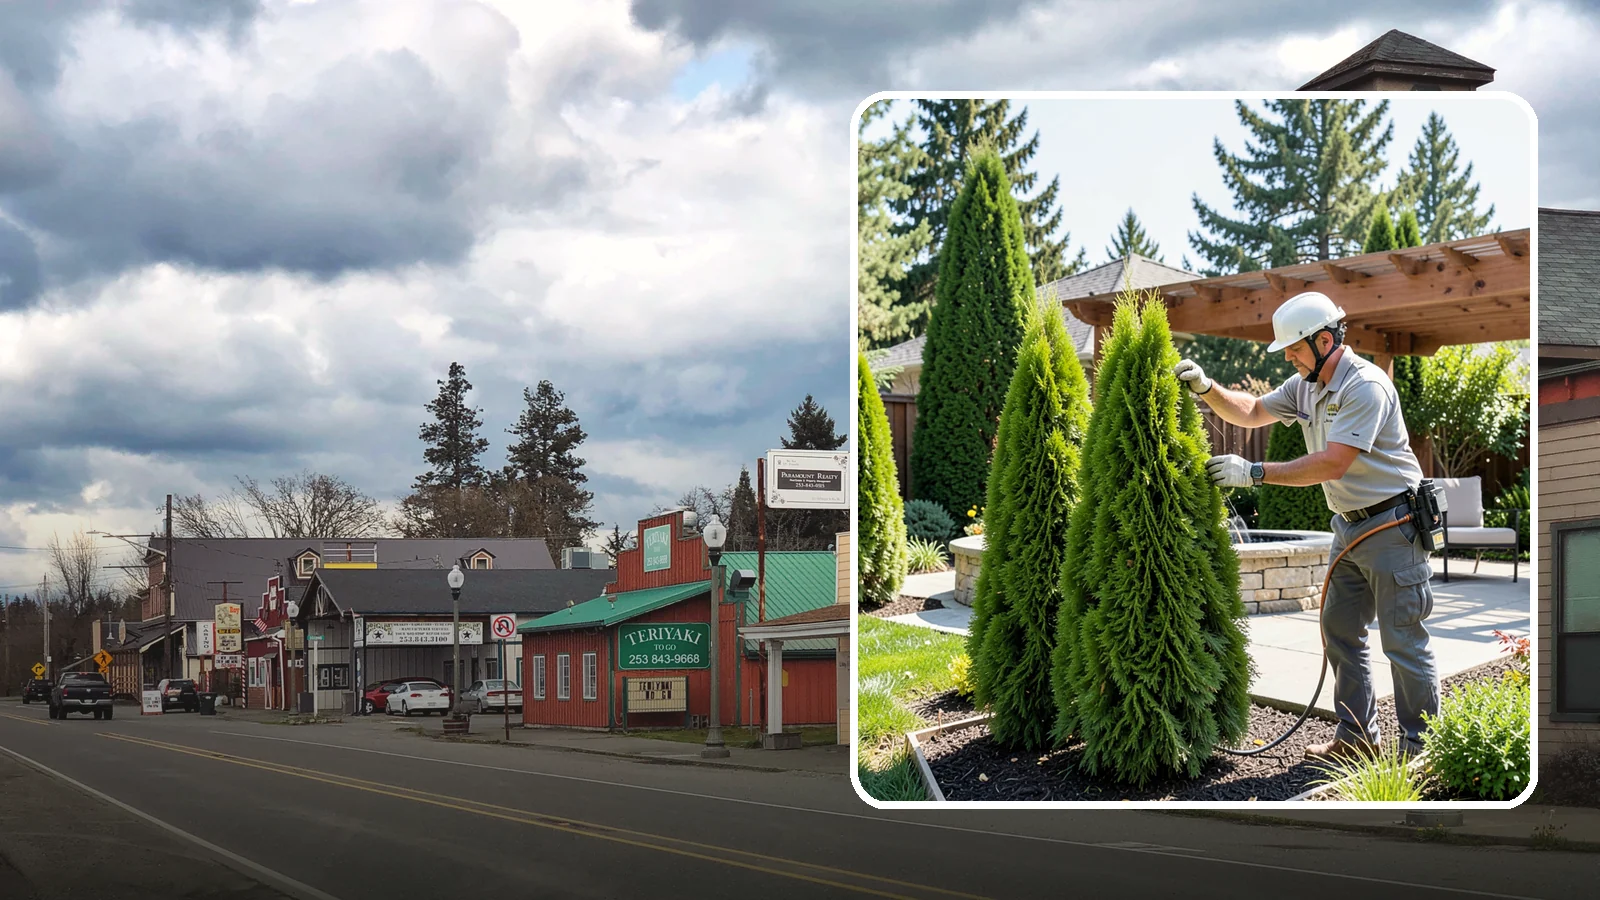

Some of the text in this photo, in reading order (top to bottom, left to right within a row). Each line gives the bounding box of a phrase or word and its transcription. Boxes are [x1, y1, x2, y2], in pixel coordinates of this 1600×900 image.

[624, 627, 702, 646] TERIYAKI
[628, 654, 700, 665] 253 843-9668
